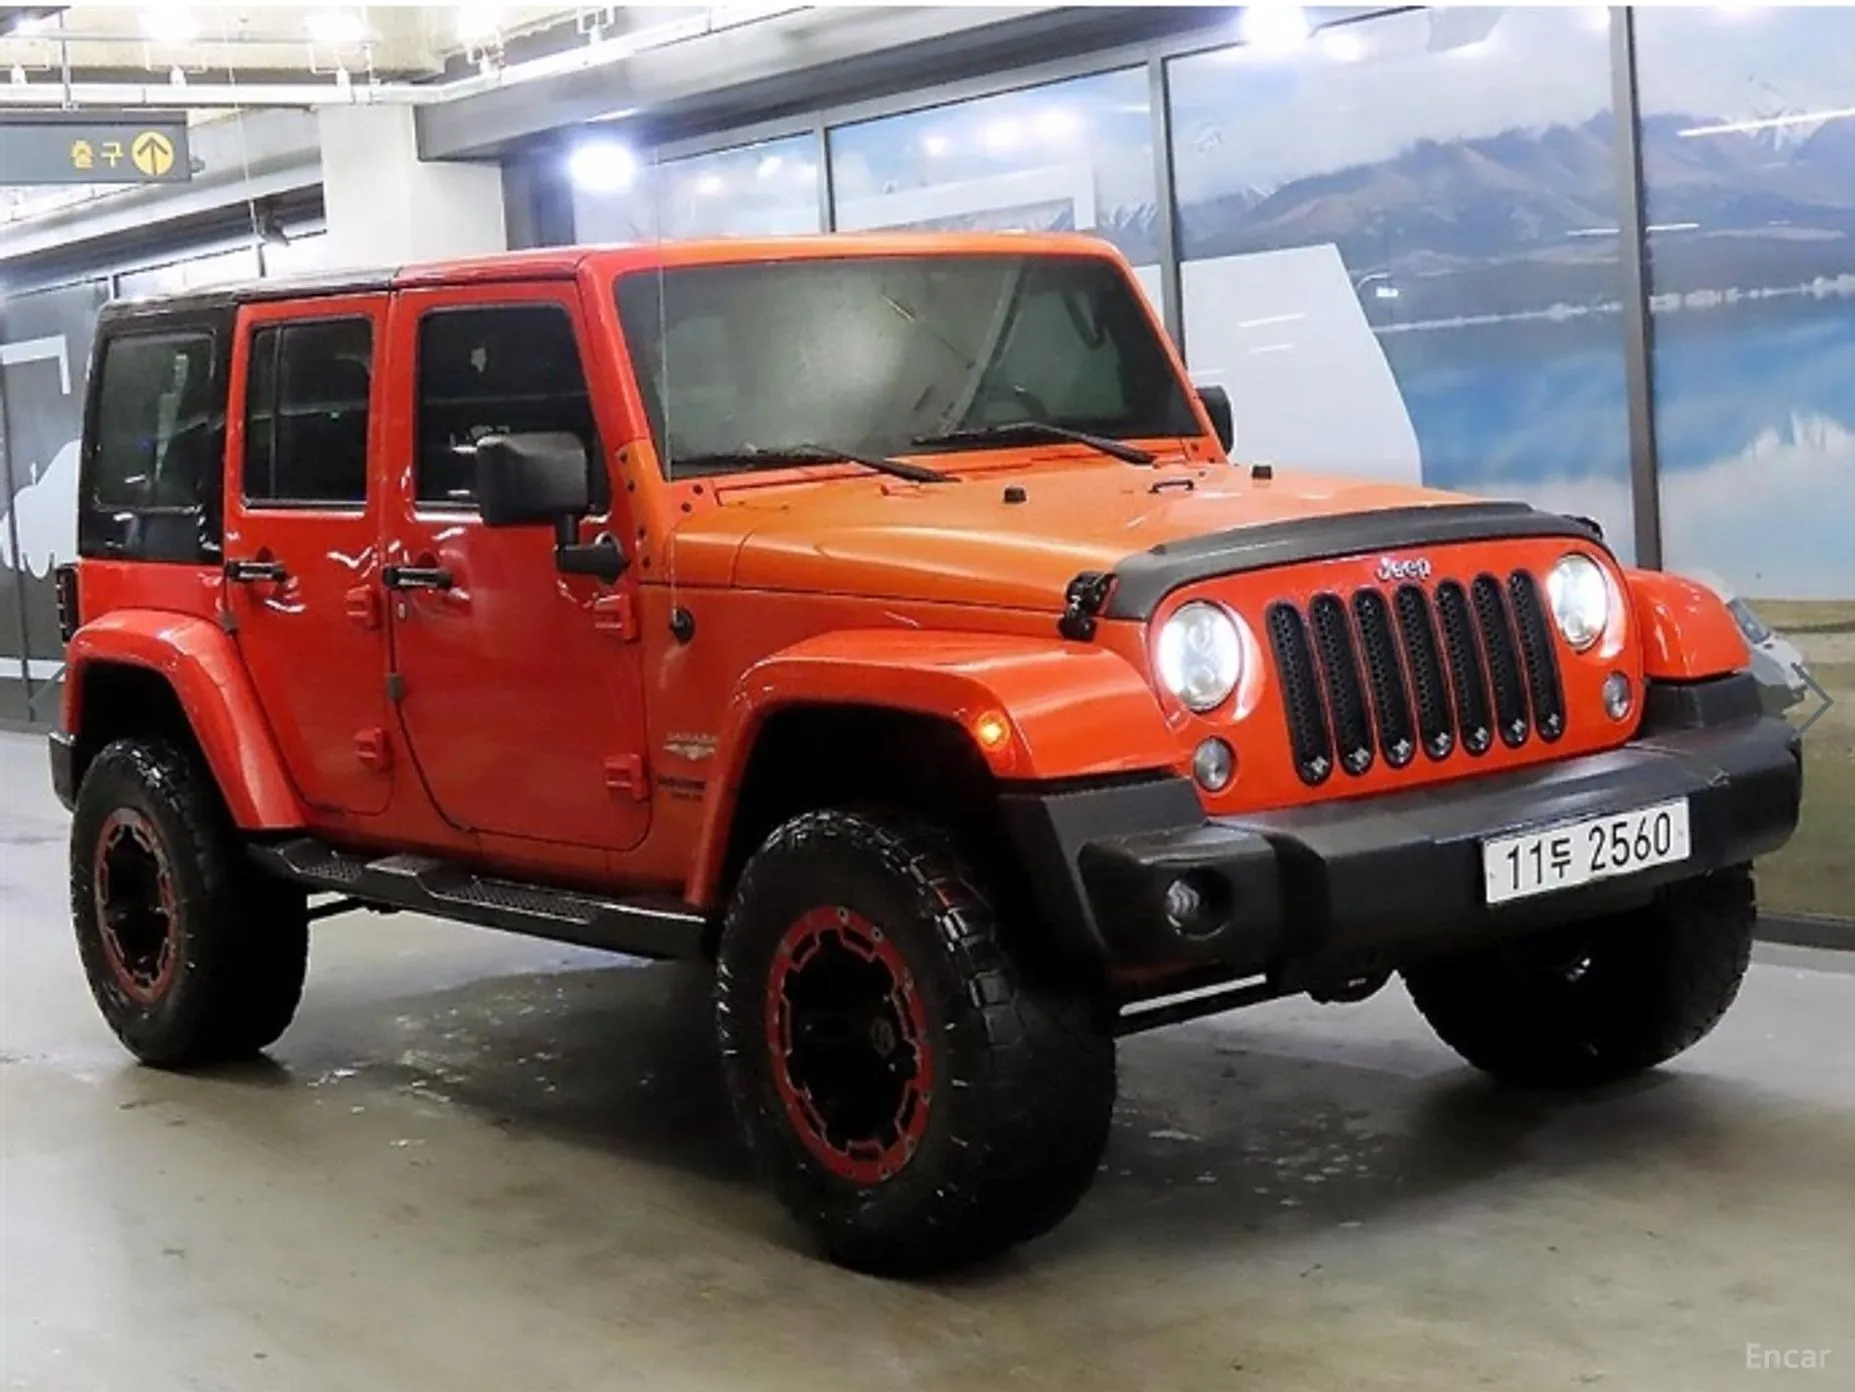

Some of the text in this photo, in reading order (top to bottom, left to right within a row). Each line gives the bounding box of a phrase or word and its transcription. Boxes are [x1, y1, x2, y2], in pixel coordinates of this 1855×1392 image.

[1377, 557, 1431, 580] Jeep
[1507, 811, 1671, 890] 11두 2560
